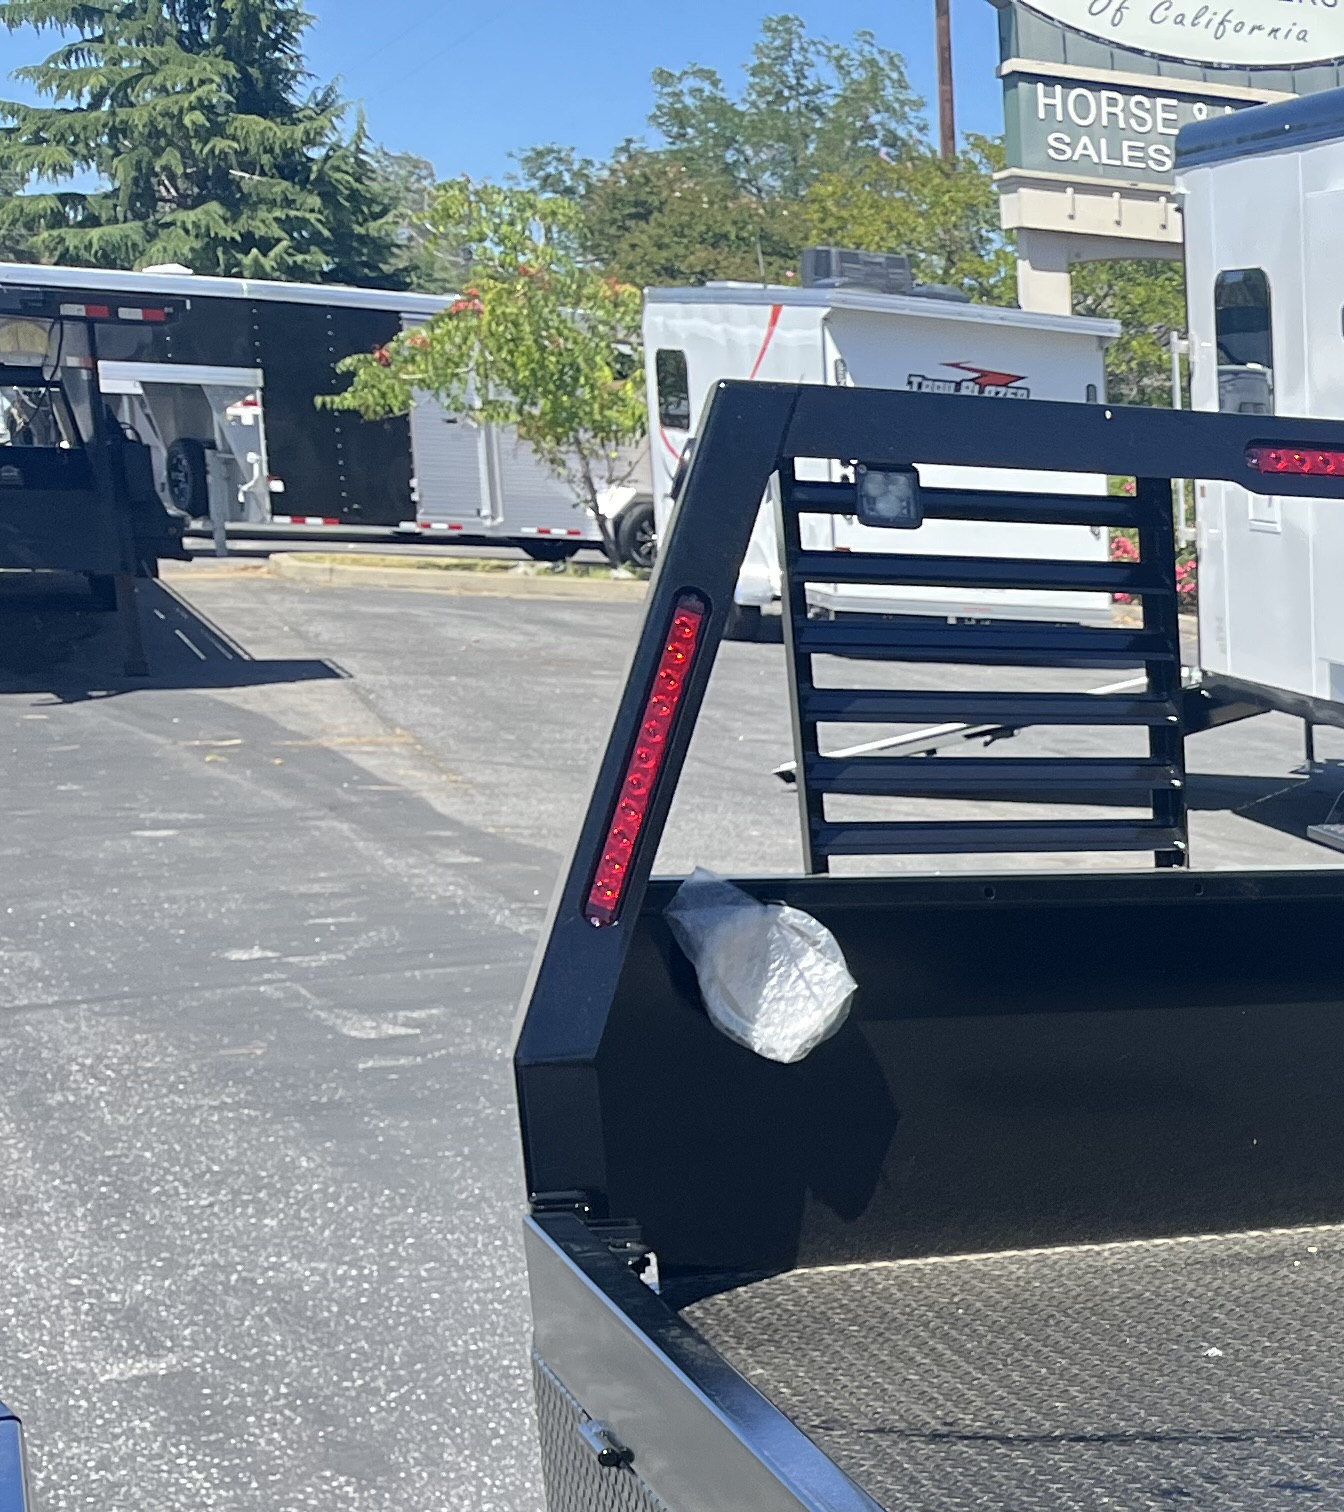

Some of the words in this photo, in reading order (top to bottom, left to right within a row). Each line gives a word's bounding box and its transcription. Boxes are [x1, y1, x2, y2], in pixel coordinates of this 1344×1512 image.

[1088, 0, 1130, 27] Of
[1150, 0, 1308, 43] California
[1036, 82, 1180, 136] HORSE
[1047, 132, 1173, 173] SALES
